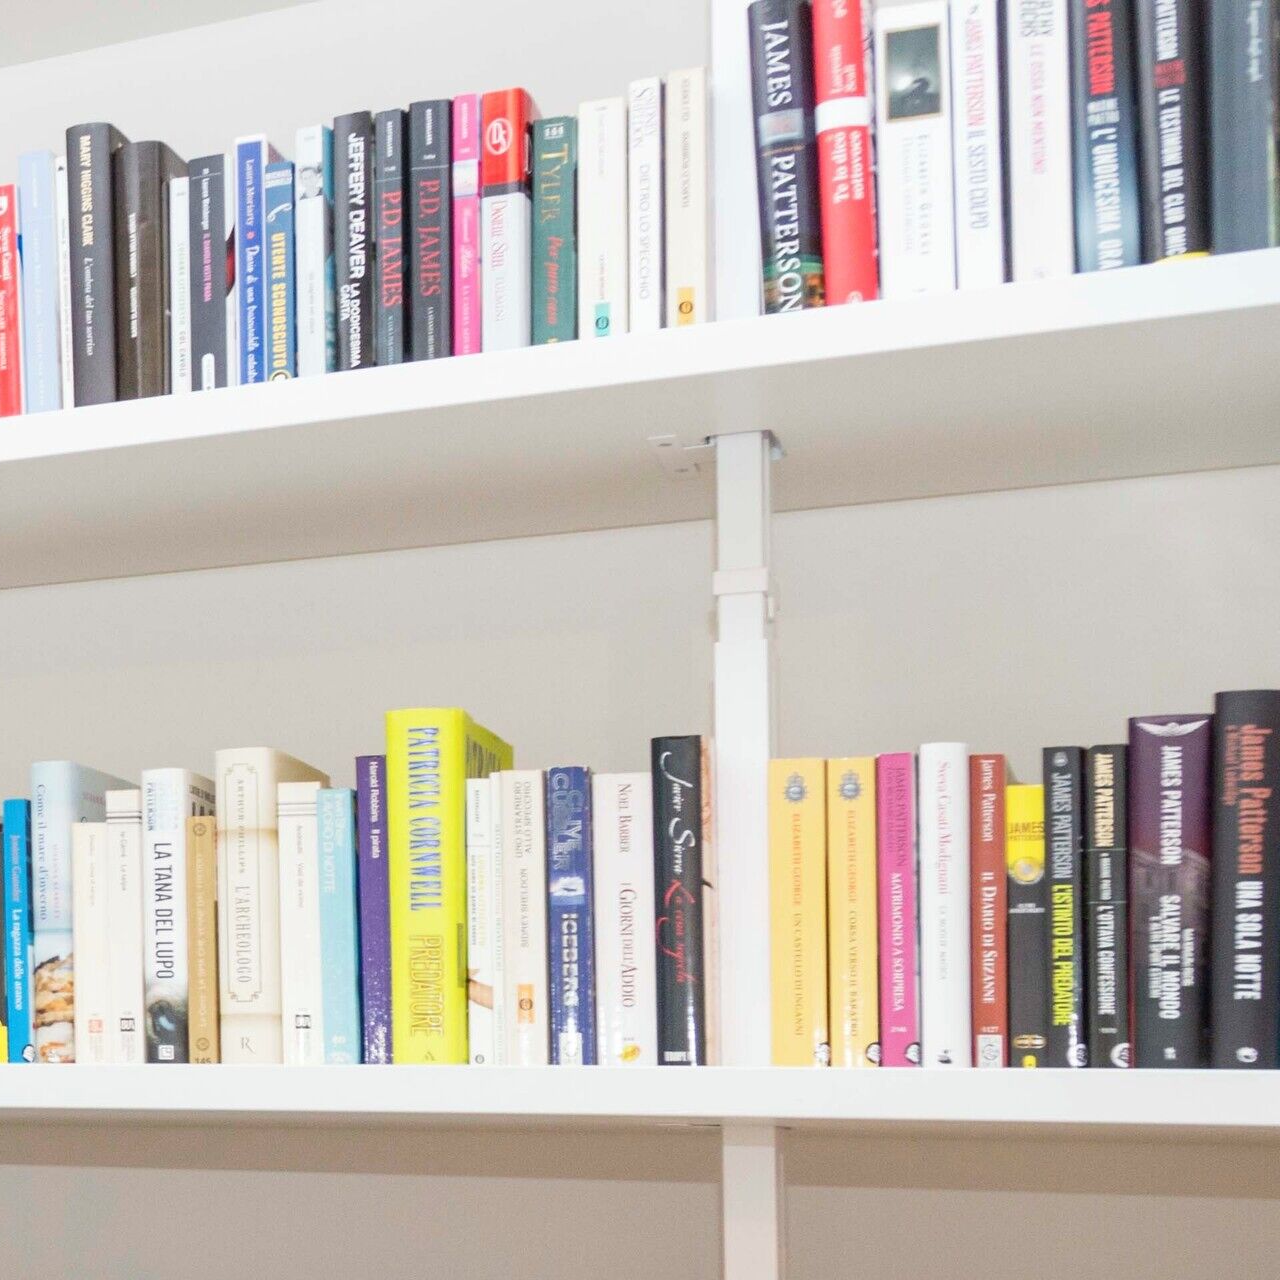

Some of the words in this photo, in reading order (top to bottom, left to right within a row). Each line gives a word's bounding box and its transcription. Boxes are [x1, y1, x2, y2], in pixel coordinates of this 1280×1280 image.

[760, 20, 792, 107] JAMES
[1087, 11, 1114, 96] PATTERSON
[80, 135, 91, 166] MARY
[347, 133, 364, 207] JEFFERY
[80, 169, 93, 212] HIGGINS
[420, 179, 440, 219] P.D.
[540, 143, 568, 224] TYLER
[639, 164, 650, 212] DIETRO
[82, 214, 94, 247] CLARK
[639, 215, 649, 233] LO
[770, 154, 803, 312] PATTERSON
[271, 232, 286, 279] UTENTE
[348, 209, 365, 280] DEAVER
[417, 226, 441, 297] JAMES
[548, 237, 562, 259] Per
[1097, 239, 1123, 272] ORA
[546, 263, 558, 293] puro
[639, 235, 650, 300] SPECCHIO
[85, 294, 94, 310] del
[340, 285, 350, 321] CARTA
[349, 283, 359, 298] LA
[272, 283, 289, 367] SCONOSCIUTO
[349, 299, 361, 367] DODICESIMA
[407, 727, 440, 809] PATRICIA
[1161, 746, 1181, 787] JAMES
[1239, 724, 1272, 781] James
[369, 761, 378, 787] Harold
[982, 759, 996, 790] James
[1050, 772, 1070, 812] JAMES
[35, 784, 47, 818] Come
[370, 789, 379, 822] Robbins
[618, 784, 632, 810] NOEL
[36, 821, 47, 830] il
[618, 815, 632, 853] BARBER
[983, 793, 996, 842] Patterson
[1161, 791, 1181, 865] PATTERSON
[1236, 788, 1272, 875] Patterson
[37, 833, 47, 862] mare
[153, 842, 172, 860] LA
[369, 834, 380, 858] pirata
[409, 817, 442, 912] CORNWELL
[1051, 815, 1071, 878] PATTERSON
[38, 866, 49, 921] d'inverno
[154, 866, 173, 902] TANA
[1235, 881, 1263, 909] UNA
[12, 909, 23, 921] La
[155, 908, 173, 936] DEL
[982, 886, 997, 929] DIARIO
[1052, 884, 1072, 936] L'ISTINTO
[1161, 895, 1180, 951] SALVARE
[11, 923, 21, 957] ragazza
[234, 886, 252, 984] L'ARCHEOLOGO
[983, 934, 996, 947] DI
[1052, 939, 1072, 961] DEL
[1234, 913, 1262, 949] SOLA
[14, 959, 24, 977] delle
[155, 941, 175, 979] LUPO
[562, 913, 579, 1006] ICEBERG
[983, 950, 998, 1002] SUZANNE
[1162, 955, 1179, 966] IL
[1235, 954, 1263, 1000] NOTTE
[409, 934, 445, 1037] PREDATORE
[1052, 964, 1073, 1026] PREDATORE
[1162, 970, 1180, 1019] MONDO
